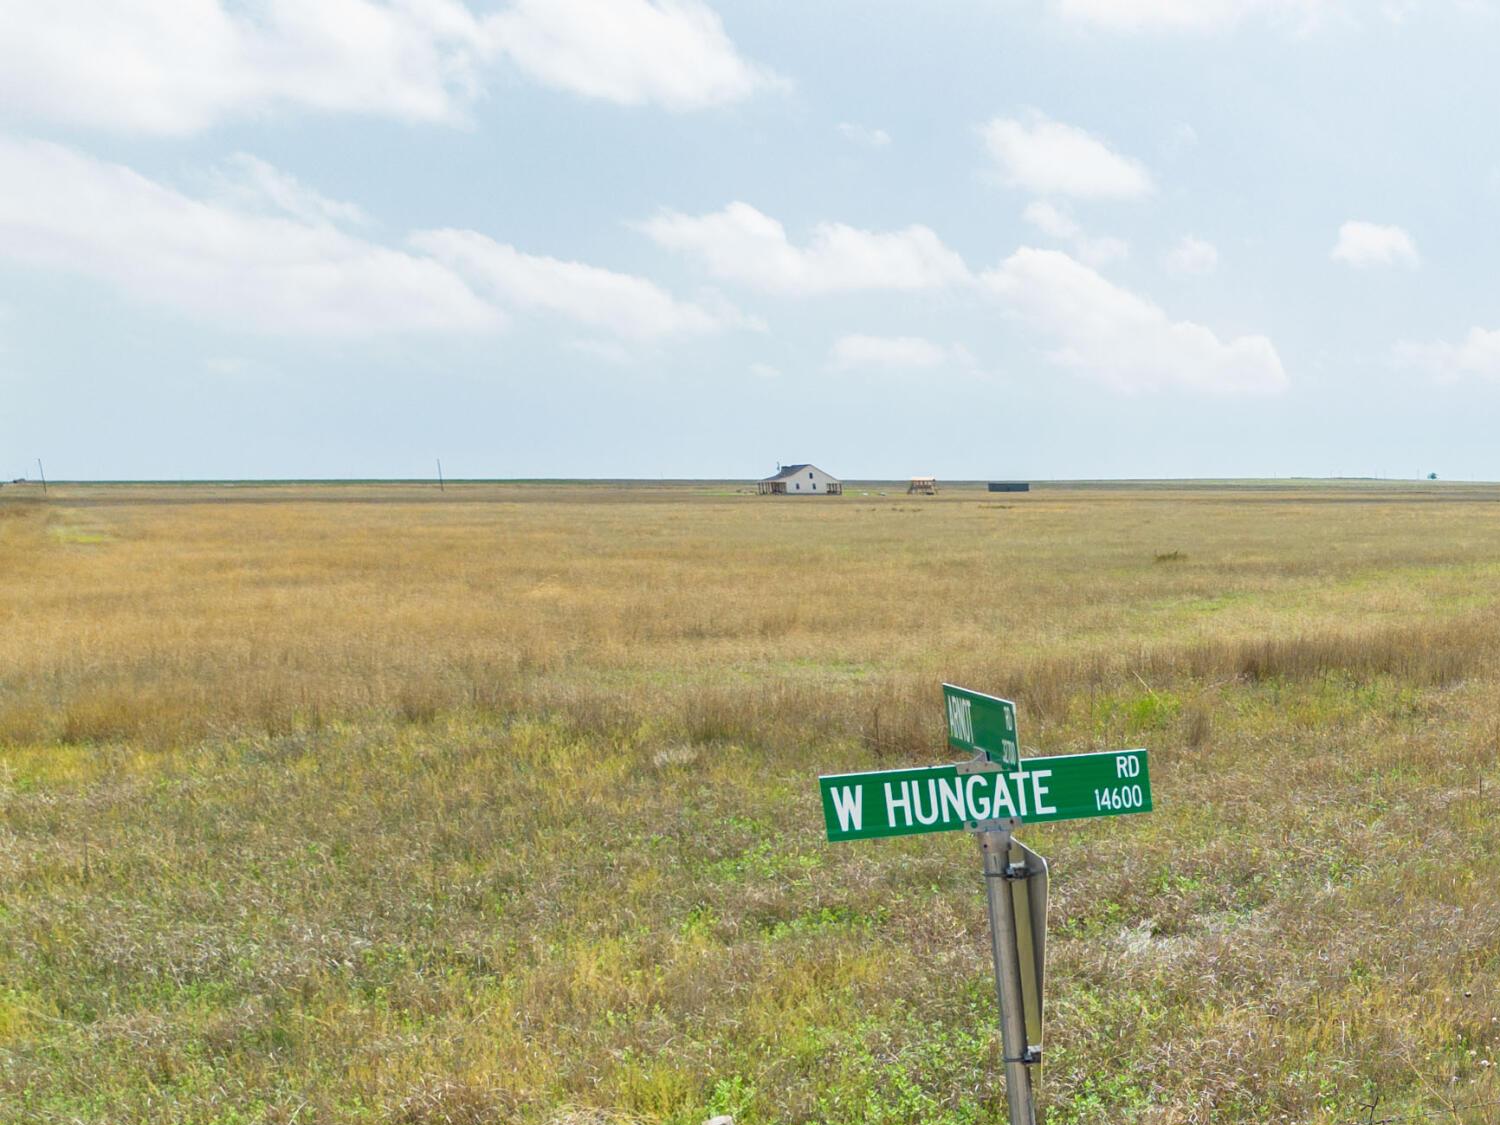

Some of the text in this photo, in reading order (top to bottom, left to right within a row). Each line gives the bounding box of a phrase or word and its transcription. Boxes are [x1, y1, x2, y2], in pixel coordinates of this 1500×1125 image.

[947, 694, 974, 744] ARNOT
[1116, 755, 1140, 779] RD
[830, 769, 1057, 832] W HUNGATE
[1094, 784, 1143, 811] 14600
